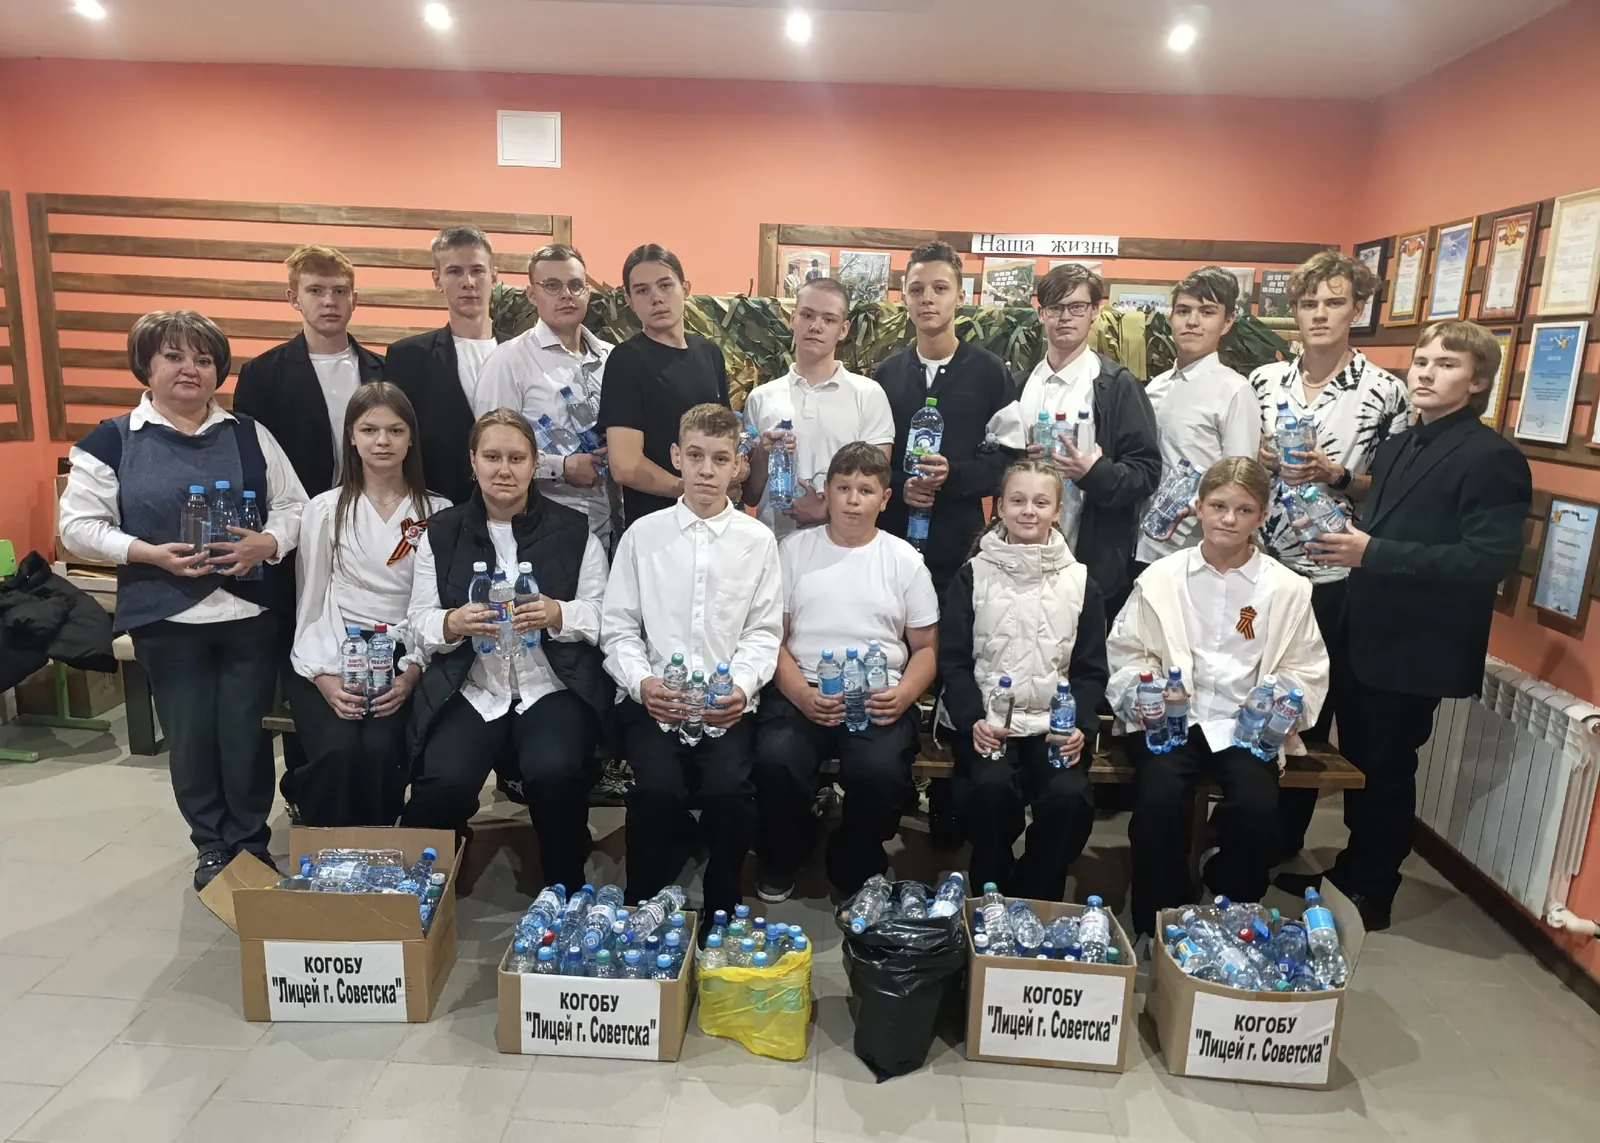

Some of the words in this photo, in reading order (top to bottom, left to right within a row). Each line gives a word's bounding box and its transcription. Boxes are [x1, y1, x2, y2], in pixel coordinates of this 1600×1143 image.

[980, 234, 1034, 252] Наша
[1051, 240, 1114, 254] жизнь
[305, 957, 362, 974] КОГОБУ
[272, 976, 320, 1008] "Лицей
[324, 985, 333, 1003] г.
[337, 978, 401, 1003] Советска"
[561, 992, 619, 1012] КОГОБУ
[1023, 986, 1082, 1006] КОГОБУ
[526, 1011, 573, 1045] "Лицей
[577, 1023, 585, 1042] г.
[591, 1016, 656, 1045] Советска"
[987, 1005, 1034, 1040] "Лицей
[1037, 1017, 1045, 1036] г.
[1051, 1010, 1118, 1041] Советска"
[1234, 1015, 1297, 1033] КОГОБУ
[1195, 1029, 1245, 1063] "Лицей
[1247, 1043, 1256, 1060] г.
[1261, 1036, 1329, 1064] Советска"
